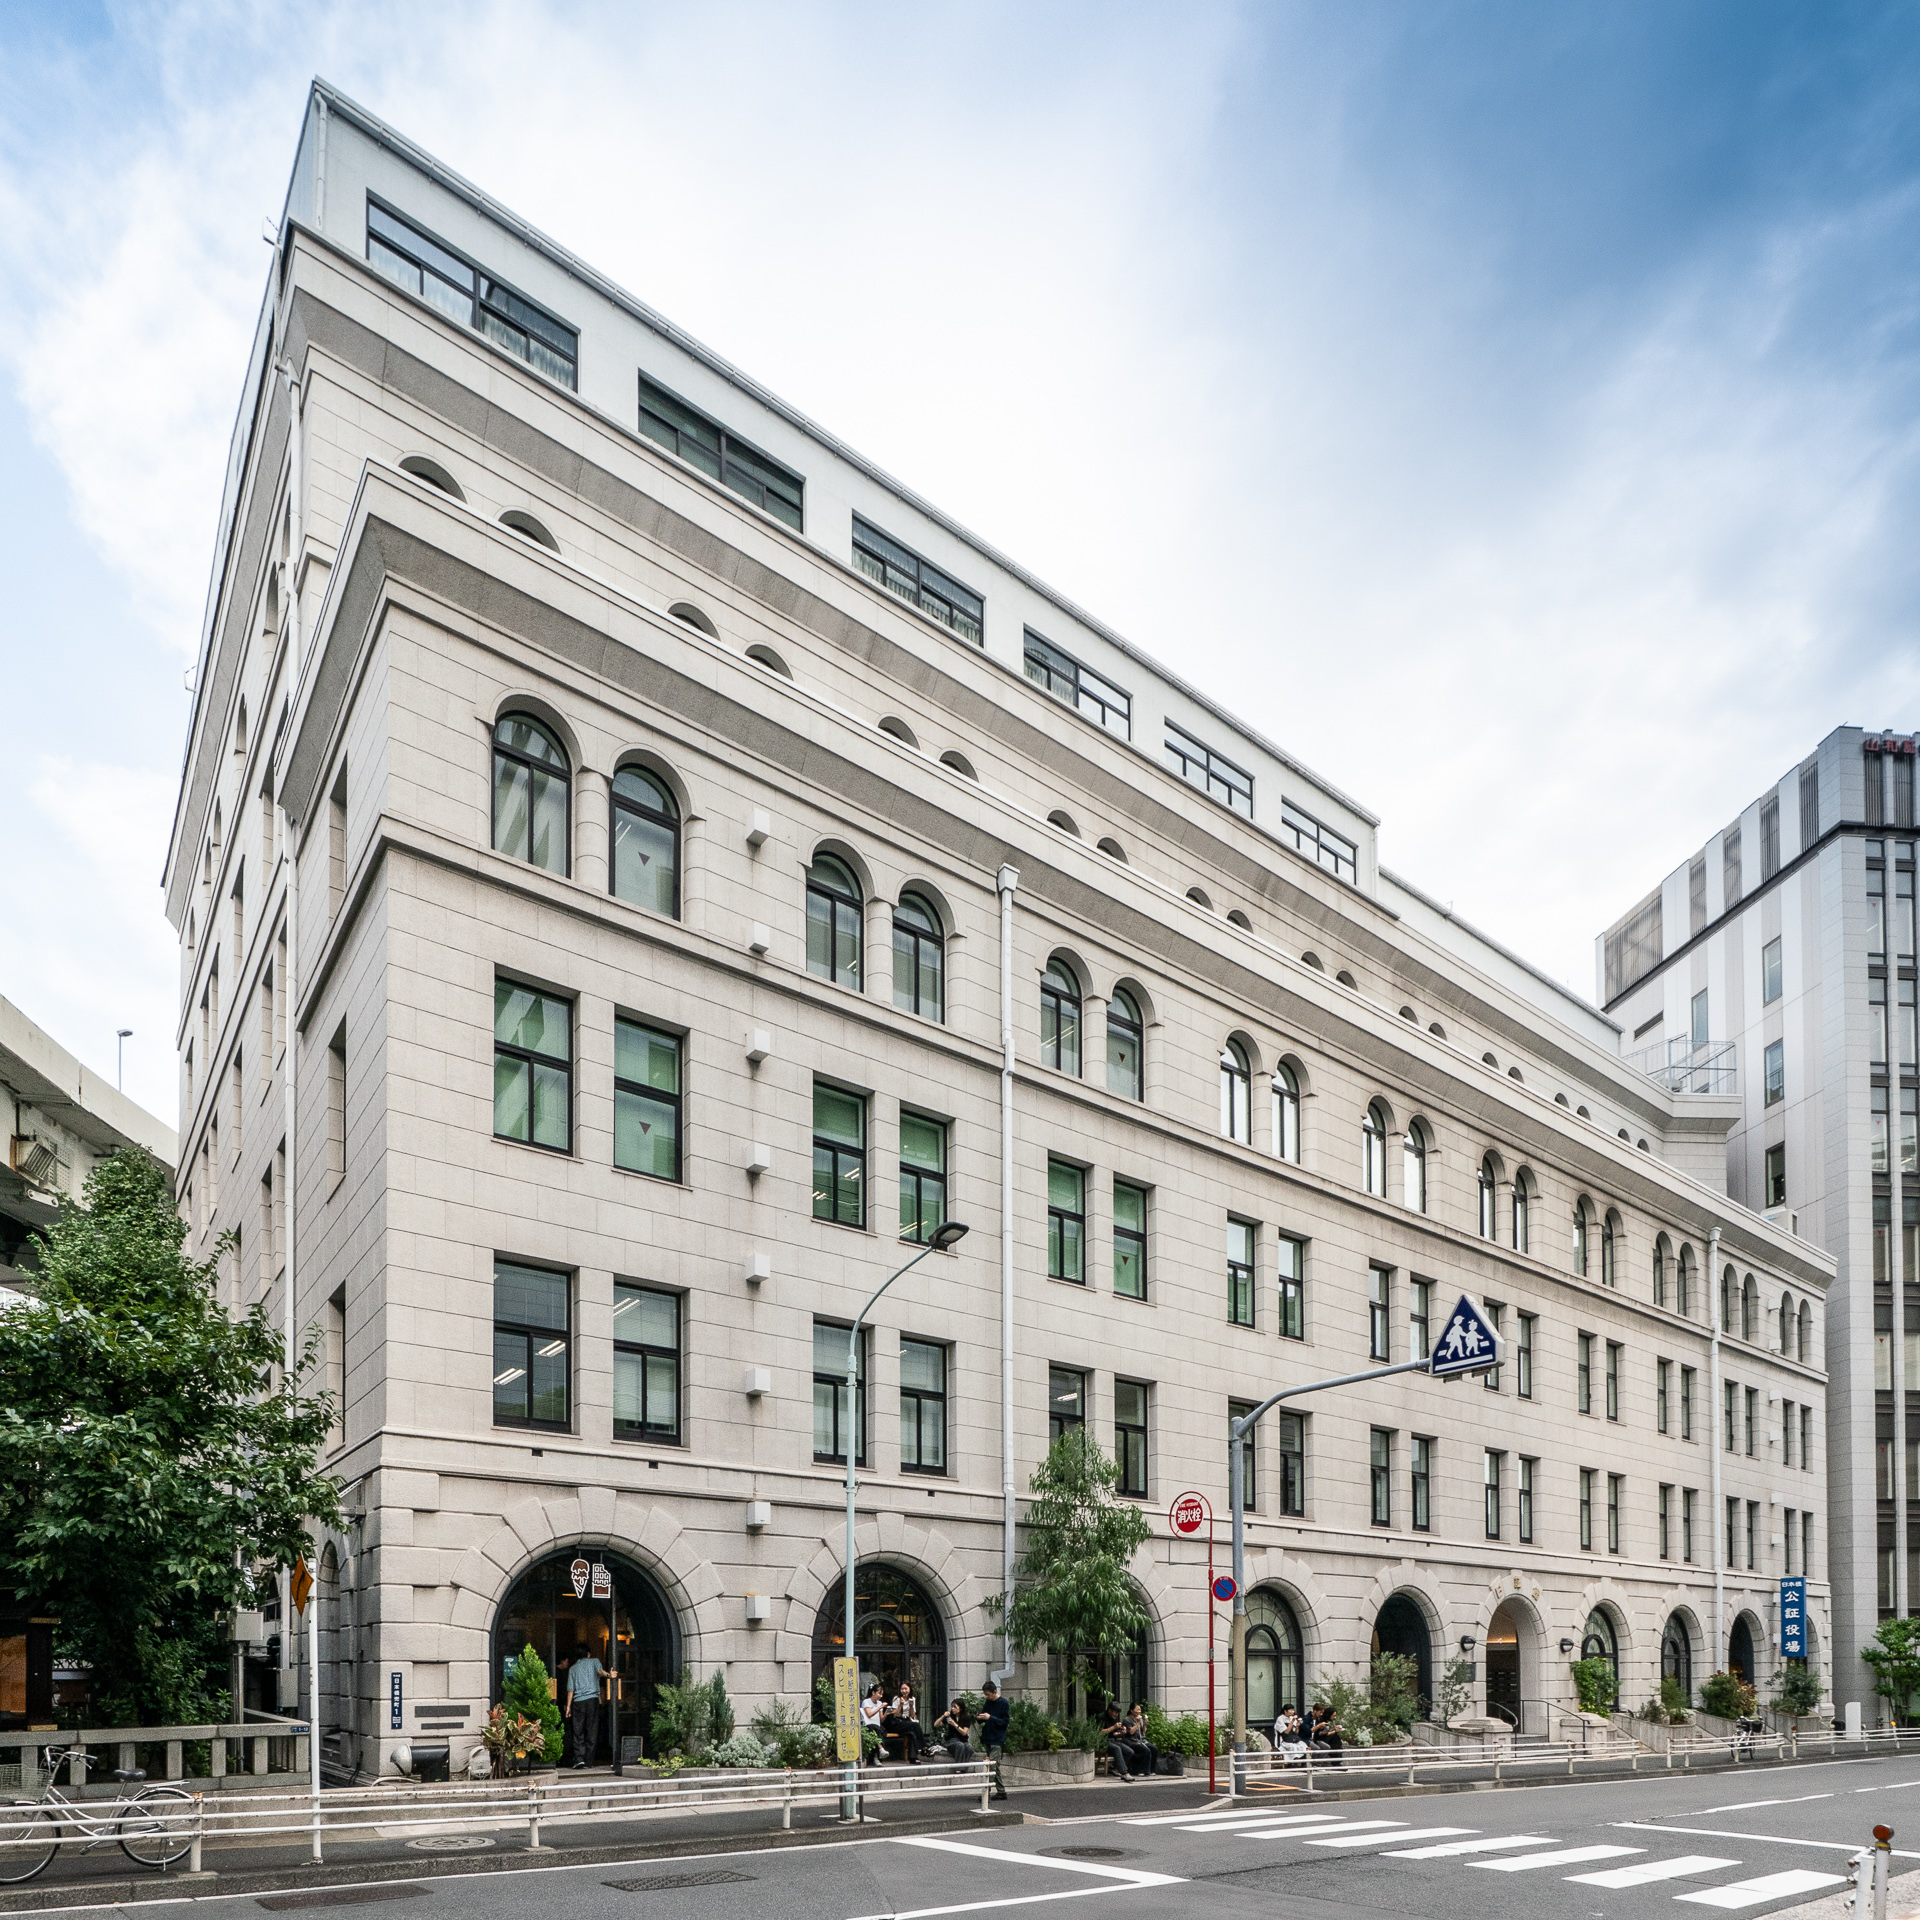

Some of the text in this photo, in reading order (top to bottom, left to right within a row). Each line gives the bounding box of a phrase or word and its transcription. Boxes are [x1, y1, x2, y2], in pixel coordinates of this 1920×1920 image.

[1177, 1508, 1201, 1524] 消火栓
[1785, 1591, 1800, 1653] 公証役場
[838, 1664, 846, 1752] スピード落とせ
[847, 1668, 856, 1739] 横断歩道あり
